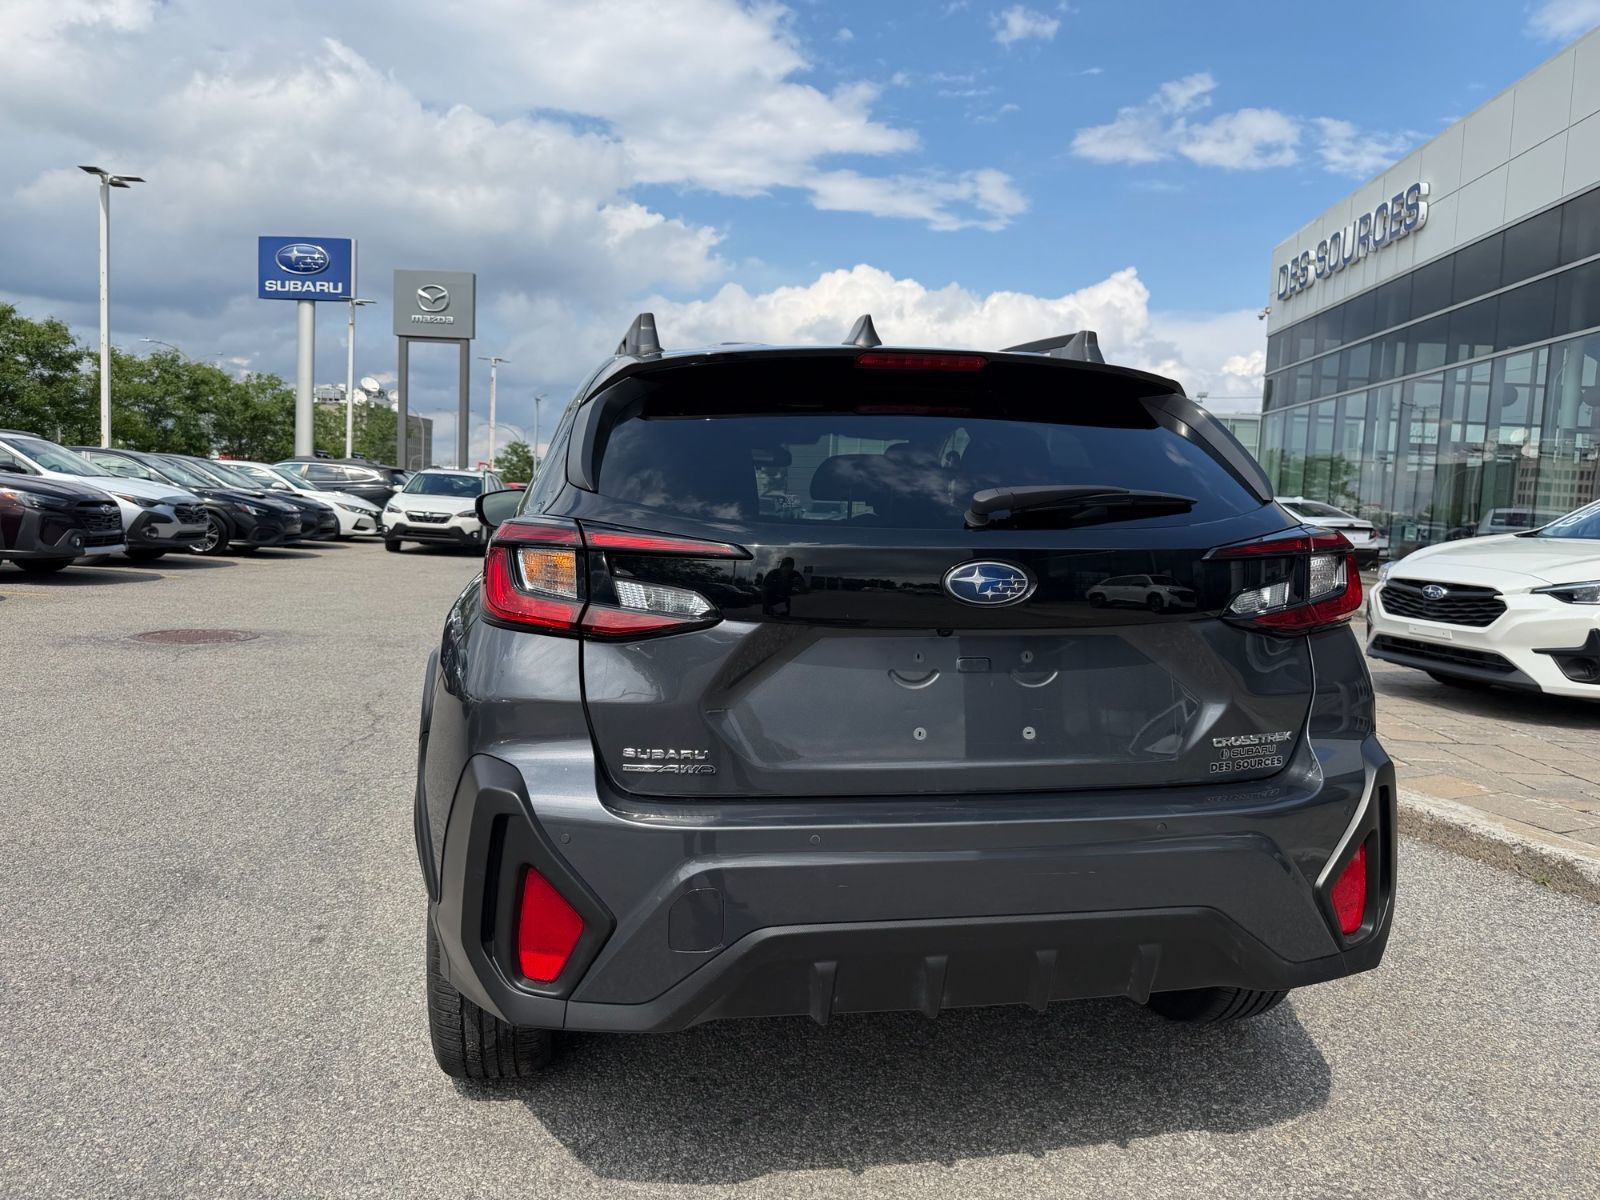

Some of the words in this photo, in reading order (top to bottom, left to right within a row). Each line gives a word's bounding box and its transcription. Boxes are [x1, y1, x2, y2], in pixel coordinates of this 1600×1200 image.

[1277, 250, 1316, 300] DES
[1315, 182, 1430, 279] SOURCES
[264, 280, 343, 294] SUBARU
[411, 314, 455, 325] mazda
[1212, 731, 1292, 747] CROSSTREK
[622, 747, 709, 760] SUBARU
[1231, 744, 1276, 758] SUBARU
[1210, 761, 1232, 773] DES
[1235, 756, 1283, 770] SOURCES
